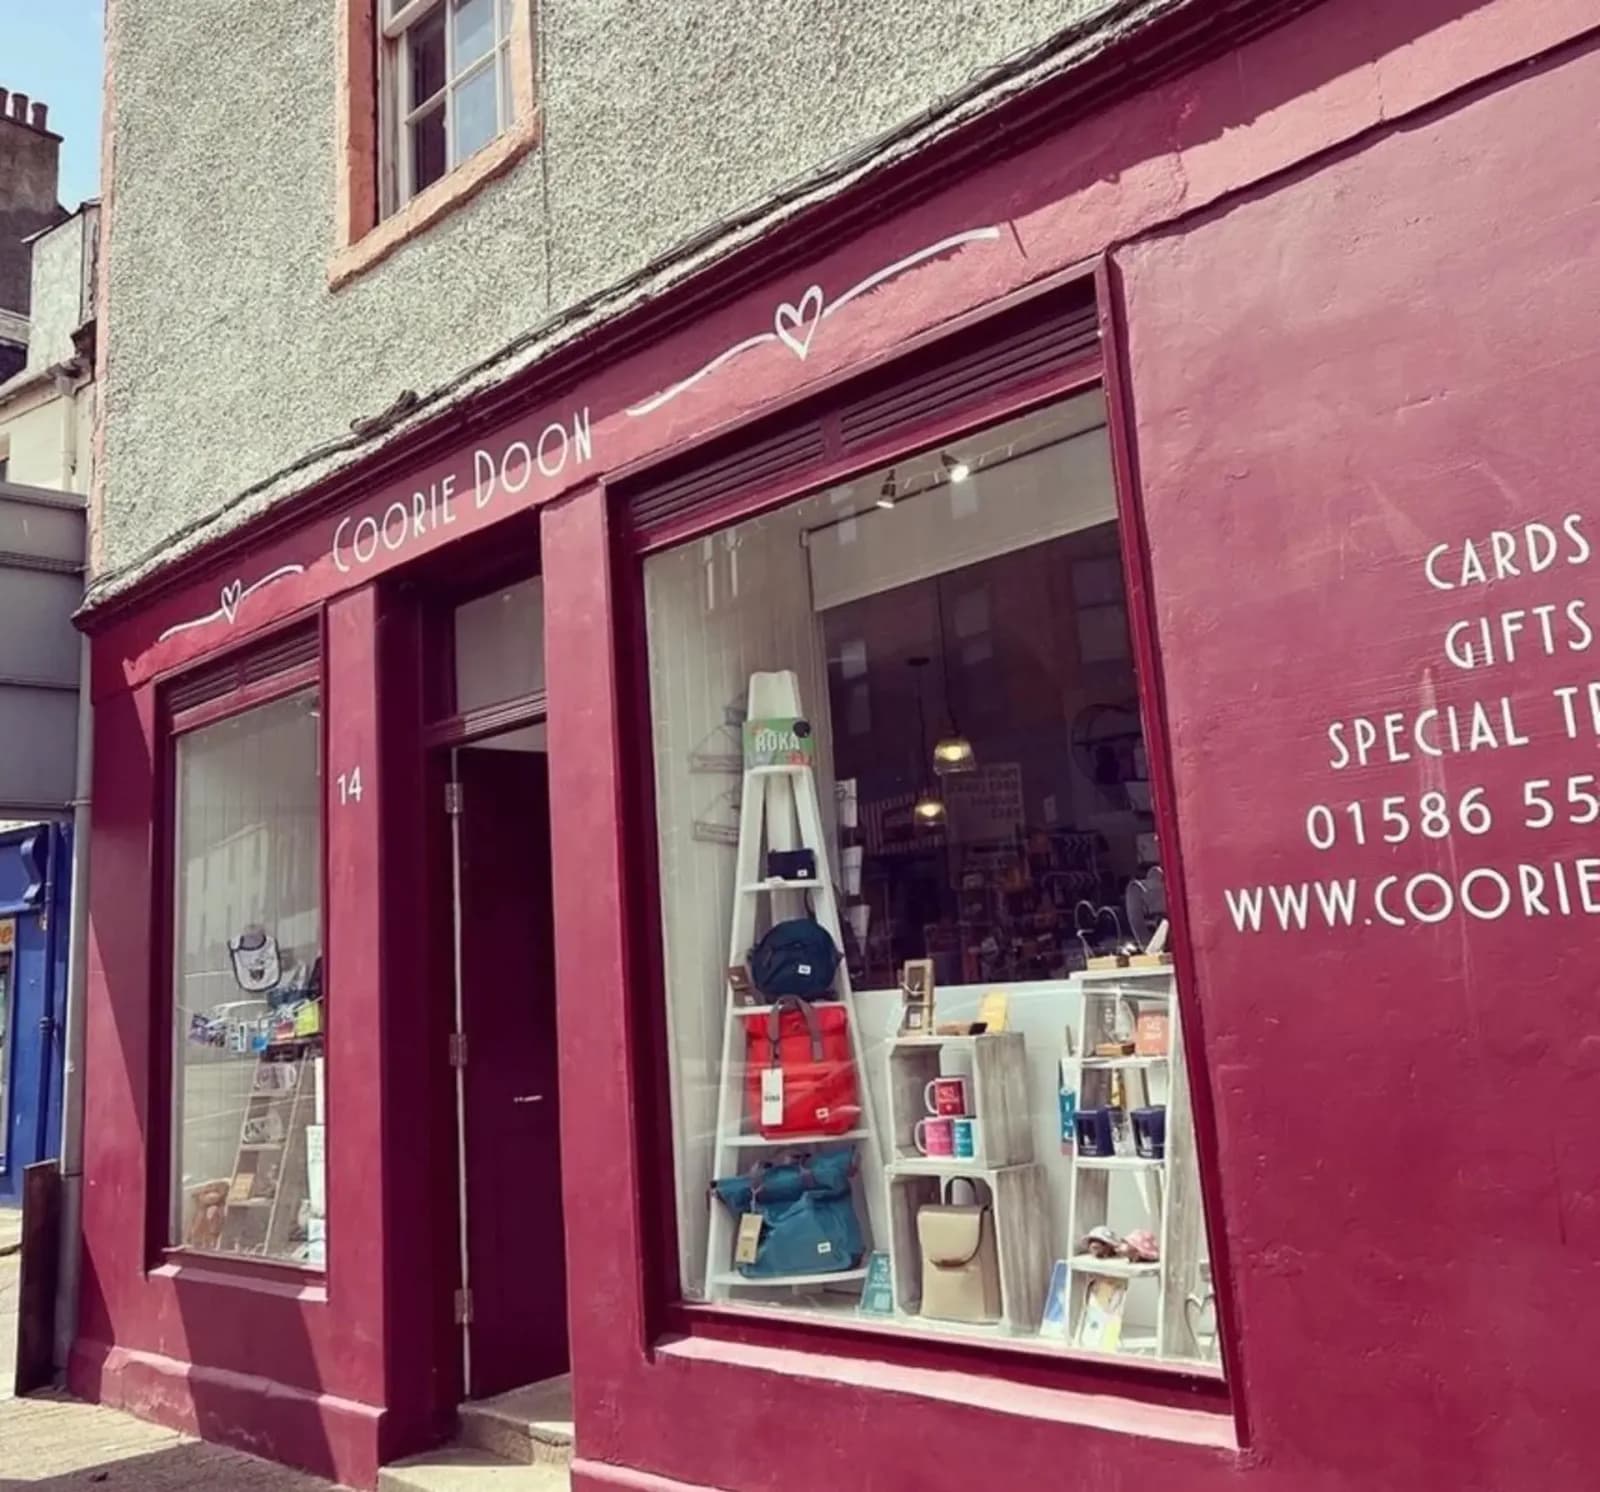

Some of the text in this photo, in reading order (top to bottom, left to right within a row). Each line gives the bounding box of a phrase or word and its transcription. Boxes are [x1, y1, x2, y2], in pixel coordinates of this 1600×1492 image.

[333, 405, 592, 573] COORIE DOON
[1424, 513, 1591, 590] CARDS
[1444, 599, 1593, 669] GIFTS
[1327, 696, 1529, 770] SPECIAL
[336, 766, 362, 806] 14
[1305, 775, 1599, 850] 01586 55
